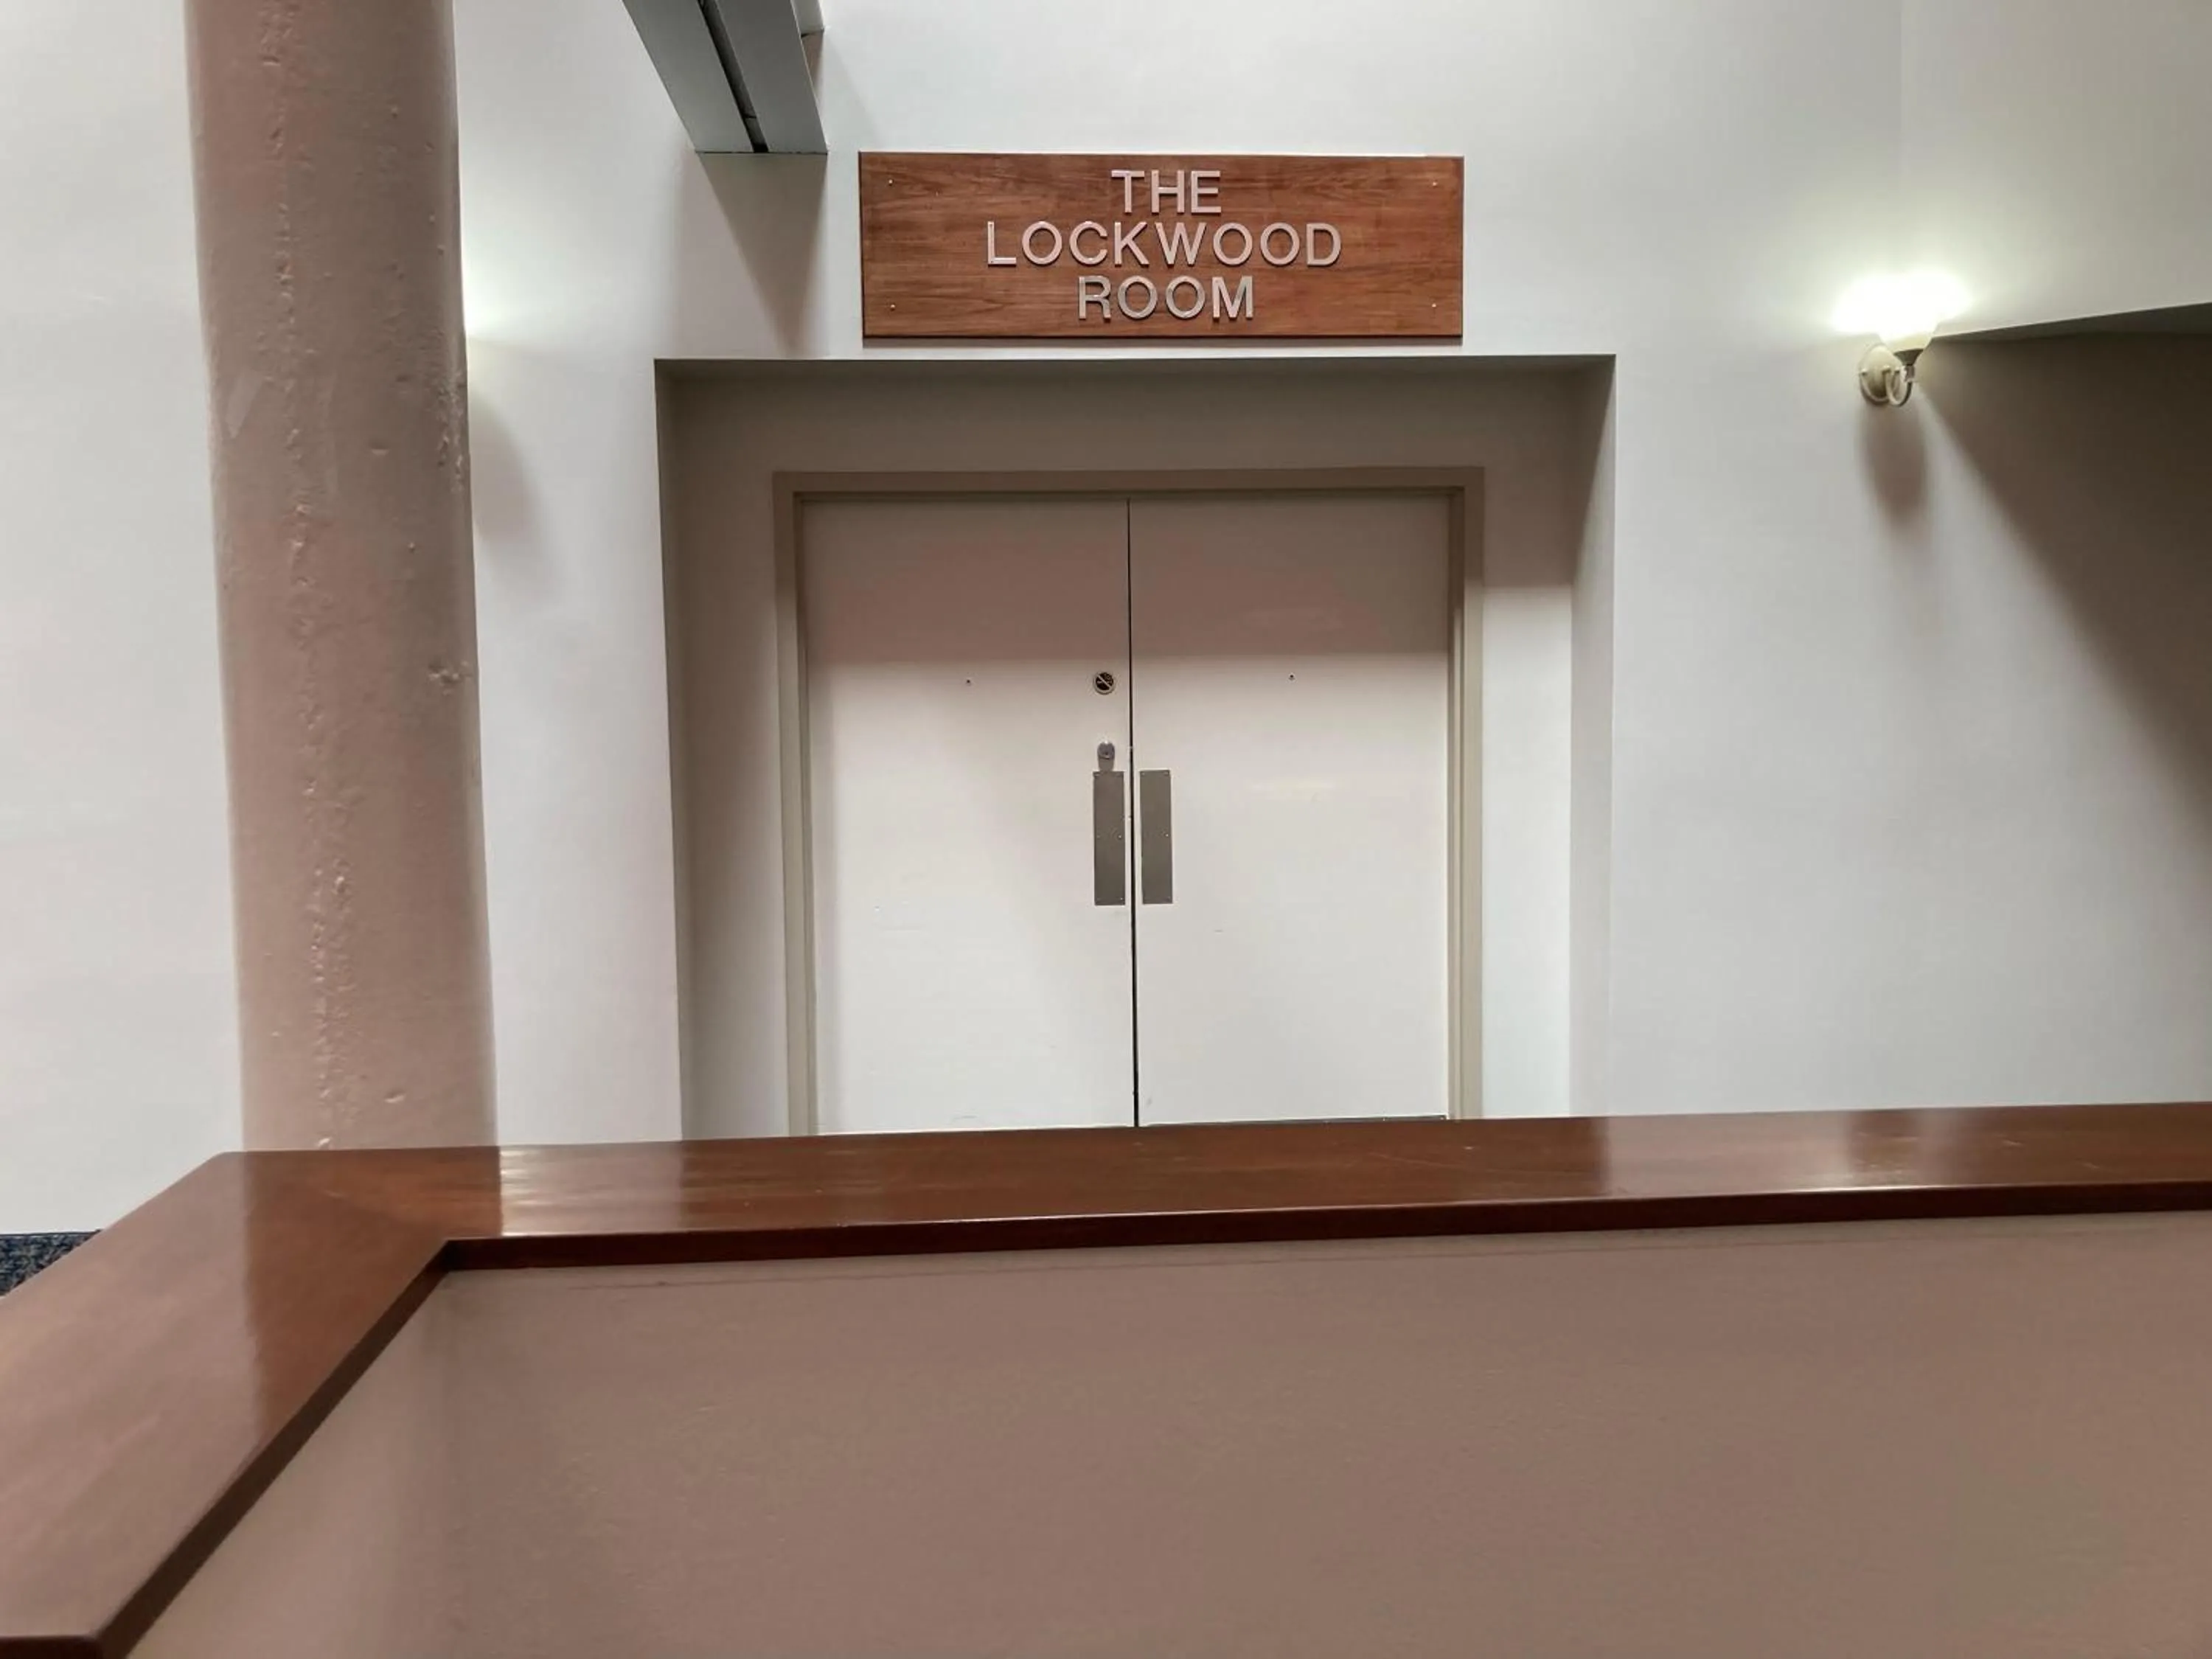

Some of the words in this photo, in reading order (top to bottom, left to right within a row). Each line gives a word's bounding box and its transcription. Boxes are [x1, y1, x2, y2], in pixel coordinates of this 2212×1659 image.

[1111, 170, 1222, 214] THE
[987, 221, 1341, 266] LOCKWOOD
[1078, 276, 1253, 320] ROOM
